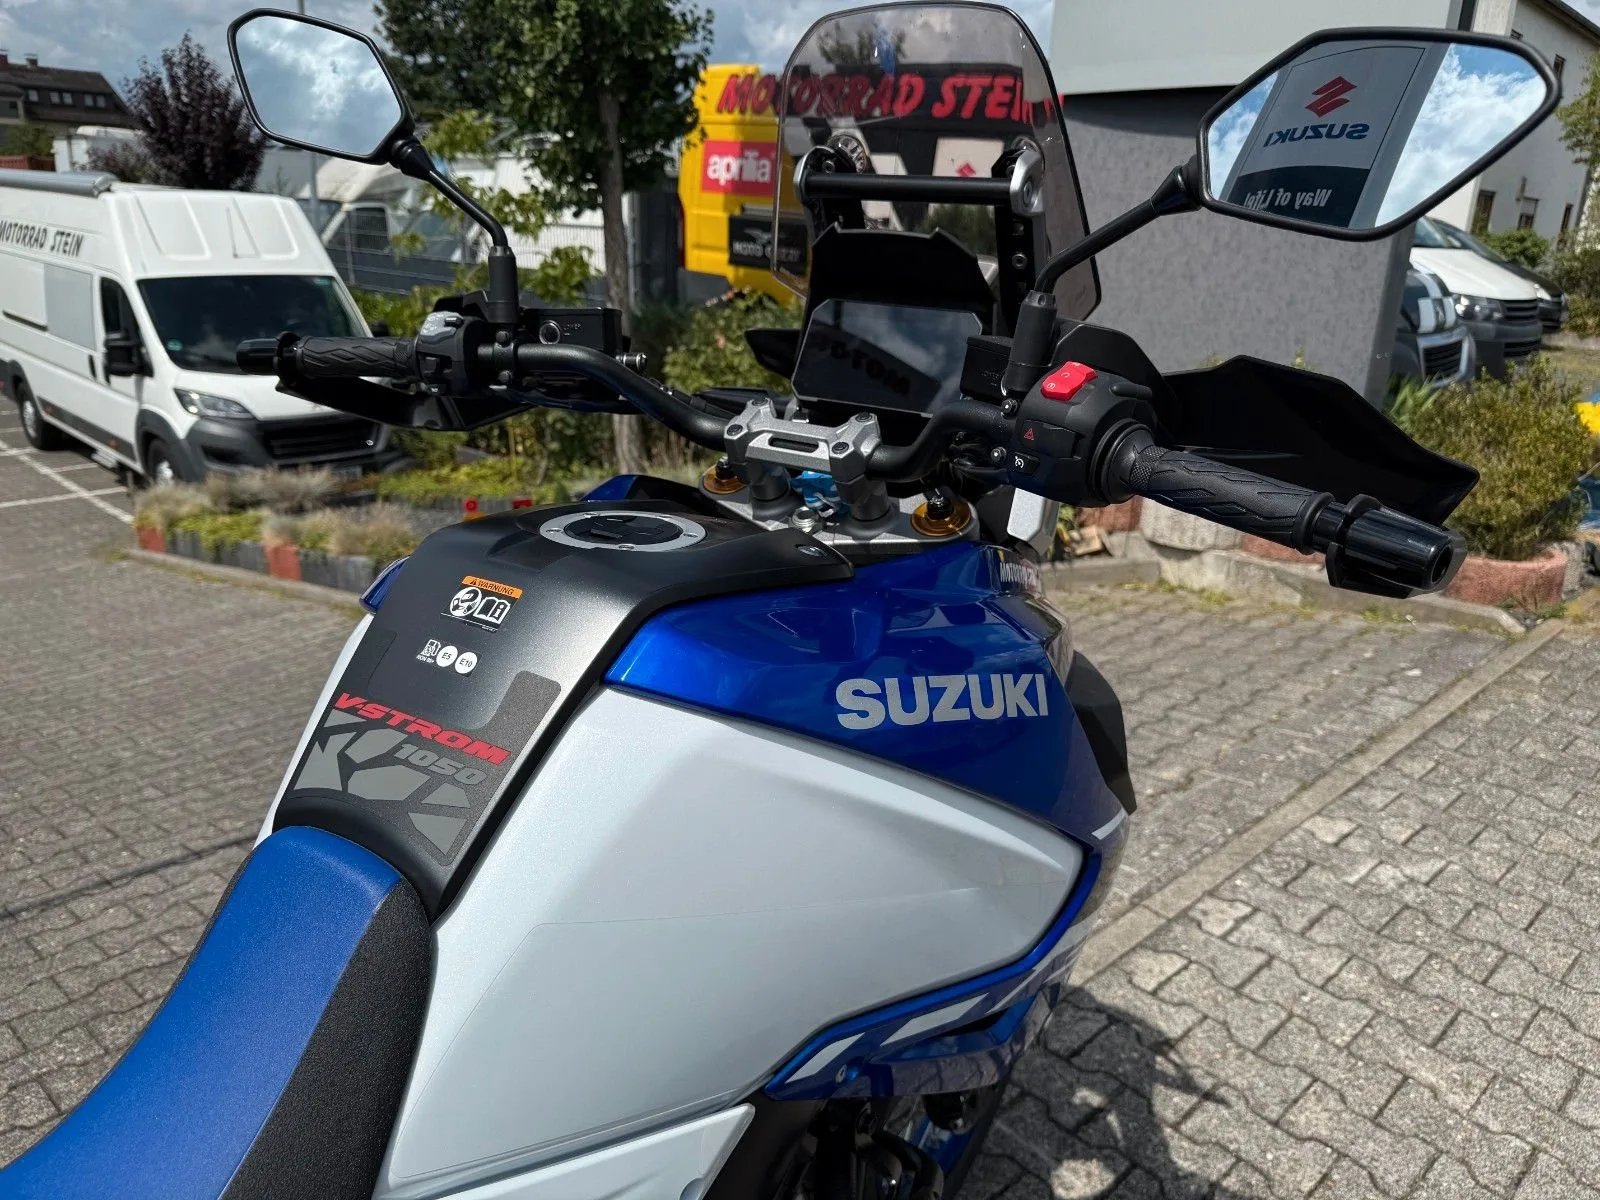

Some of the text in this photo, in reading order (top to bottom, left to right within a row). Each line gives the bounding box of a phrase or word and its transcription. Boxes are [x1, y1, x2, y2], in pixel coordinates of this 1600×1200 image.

[0, 220, 84, 257] MOTORRAD STEIN
[478, 580, 514, 595] WARNUNG
[442, 652, 452, 660] E5
[460, 658, 472, 667] E10
[836, 674, 1048, 729] SUZUKI
[394, 743, 487, 785] 1050
